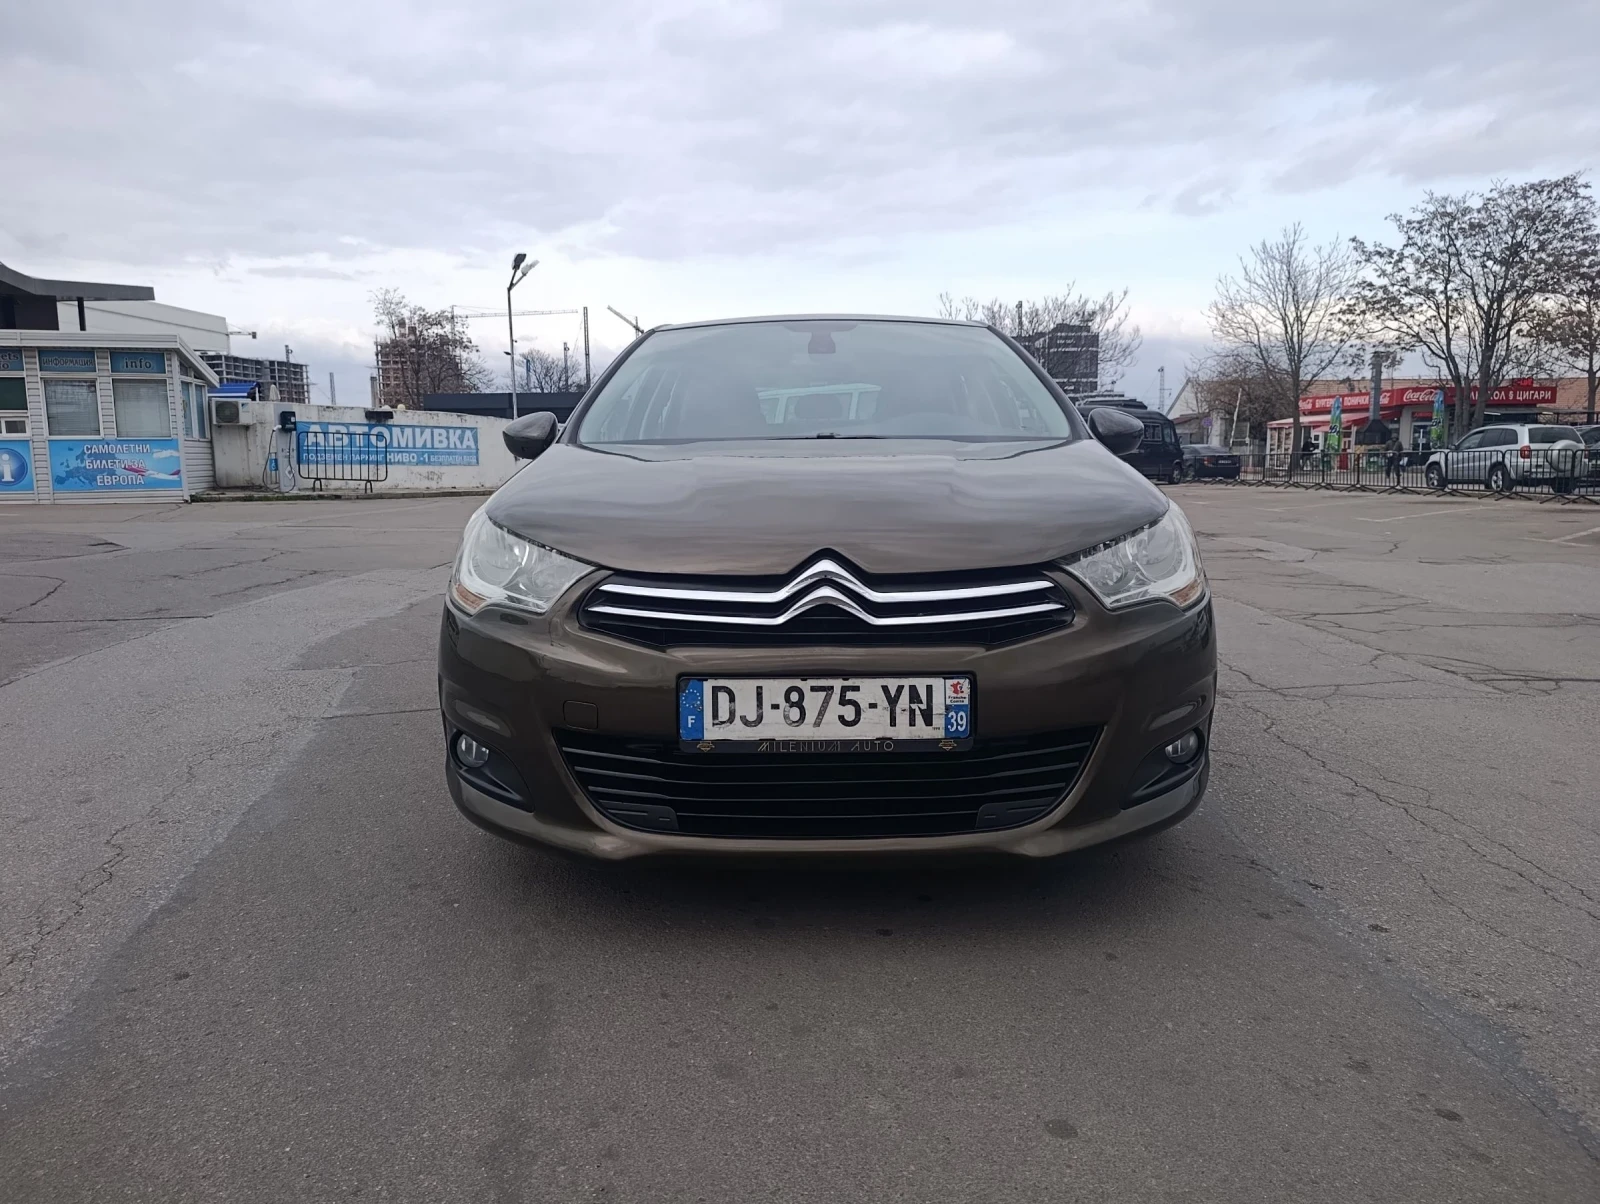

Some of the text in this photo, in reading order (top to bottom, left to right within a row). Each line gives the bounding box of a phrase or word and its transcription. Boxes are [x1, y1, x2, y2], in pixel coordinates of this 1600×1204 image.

[125, 358, 152, 369] info
[1516, 391, 1552, 401] ЦИГАРИ
[304, 424, 476, 449] АВТОМИВКА
[84, 444, 151, 454] САМОЛЕТНИ
[387, 453, 417, 462] НИВО
[86, 460, 146, 469] БИЛЕТИ ЗА
[97, 476, 145, 486] ЕВРОПА
[712, 684, 934, 728] DJ-875-YN
[687, 715, 696, 728] F
[947, 711, 967, 732] 39
[851, 741, 894, 752] AUTO
